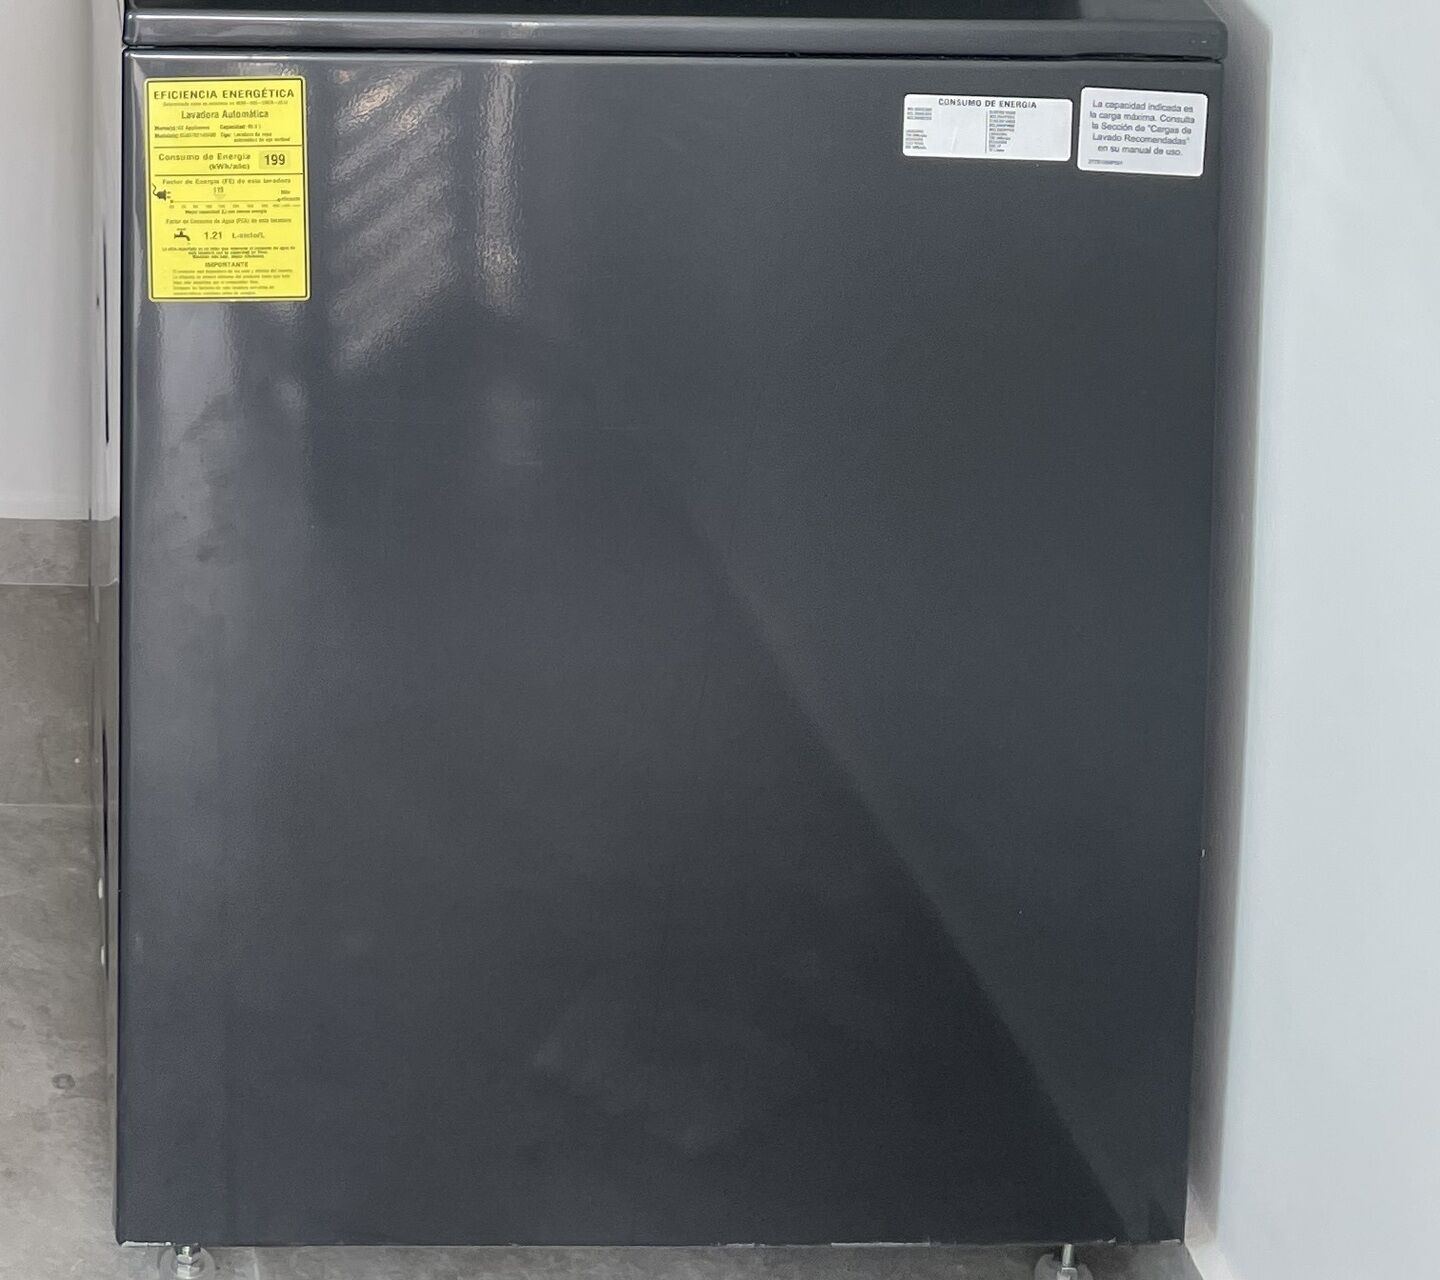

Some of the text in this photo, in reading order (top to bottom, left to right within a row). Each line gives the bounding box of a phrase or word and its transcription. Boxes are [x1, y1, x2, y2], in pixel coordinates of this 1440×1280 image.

[154, 88, 294, 99] EFICIENCIA ENERGÉTICA
[939, 99, 981, 107] CONSUMO
[1105, 102, 1145, 110] capacidad
[1148, 103, 1181, 112] indicada
[181, 110, 269, 119] Lavadora Automática
[1099, 113, 1121, 121] carga
[1160, 114, 1195, 123] Consulta
[1102, 122, 1133, 131] Sección
[1148, 125, 1179, 134] "Cargas
[1092, 133, 1190, 145] Lavado Recomendadas"
[1122, 146, 1151, 154] manual
[264, 154, 285, 165] 199
